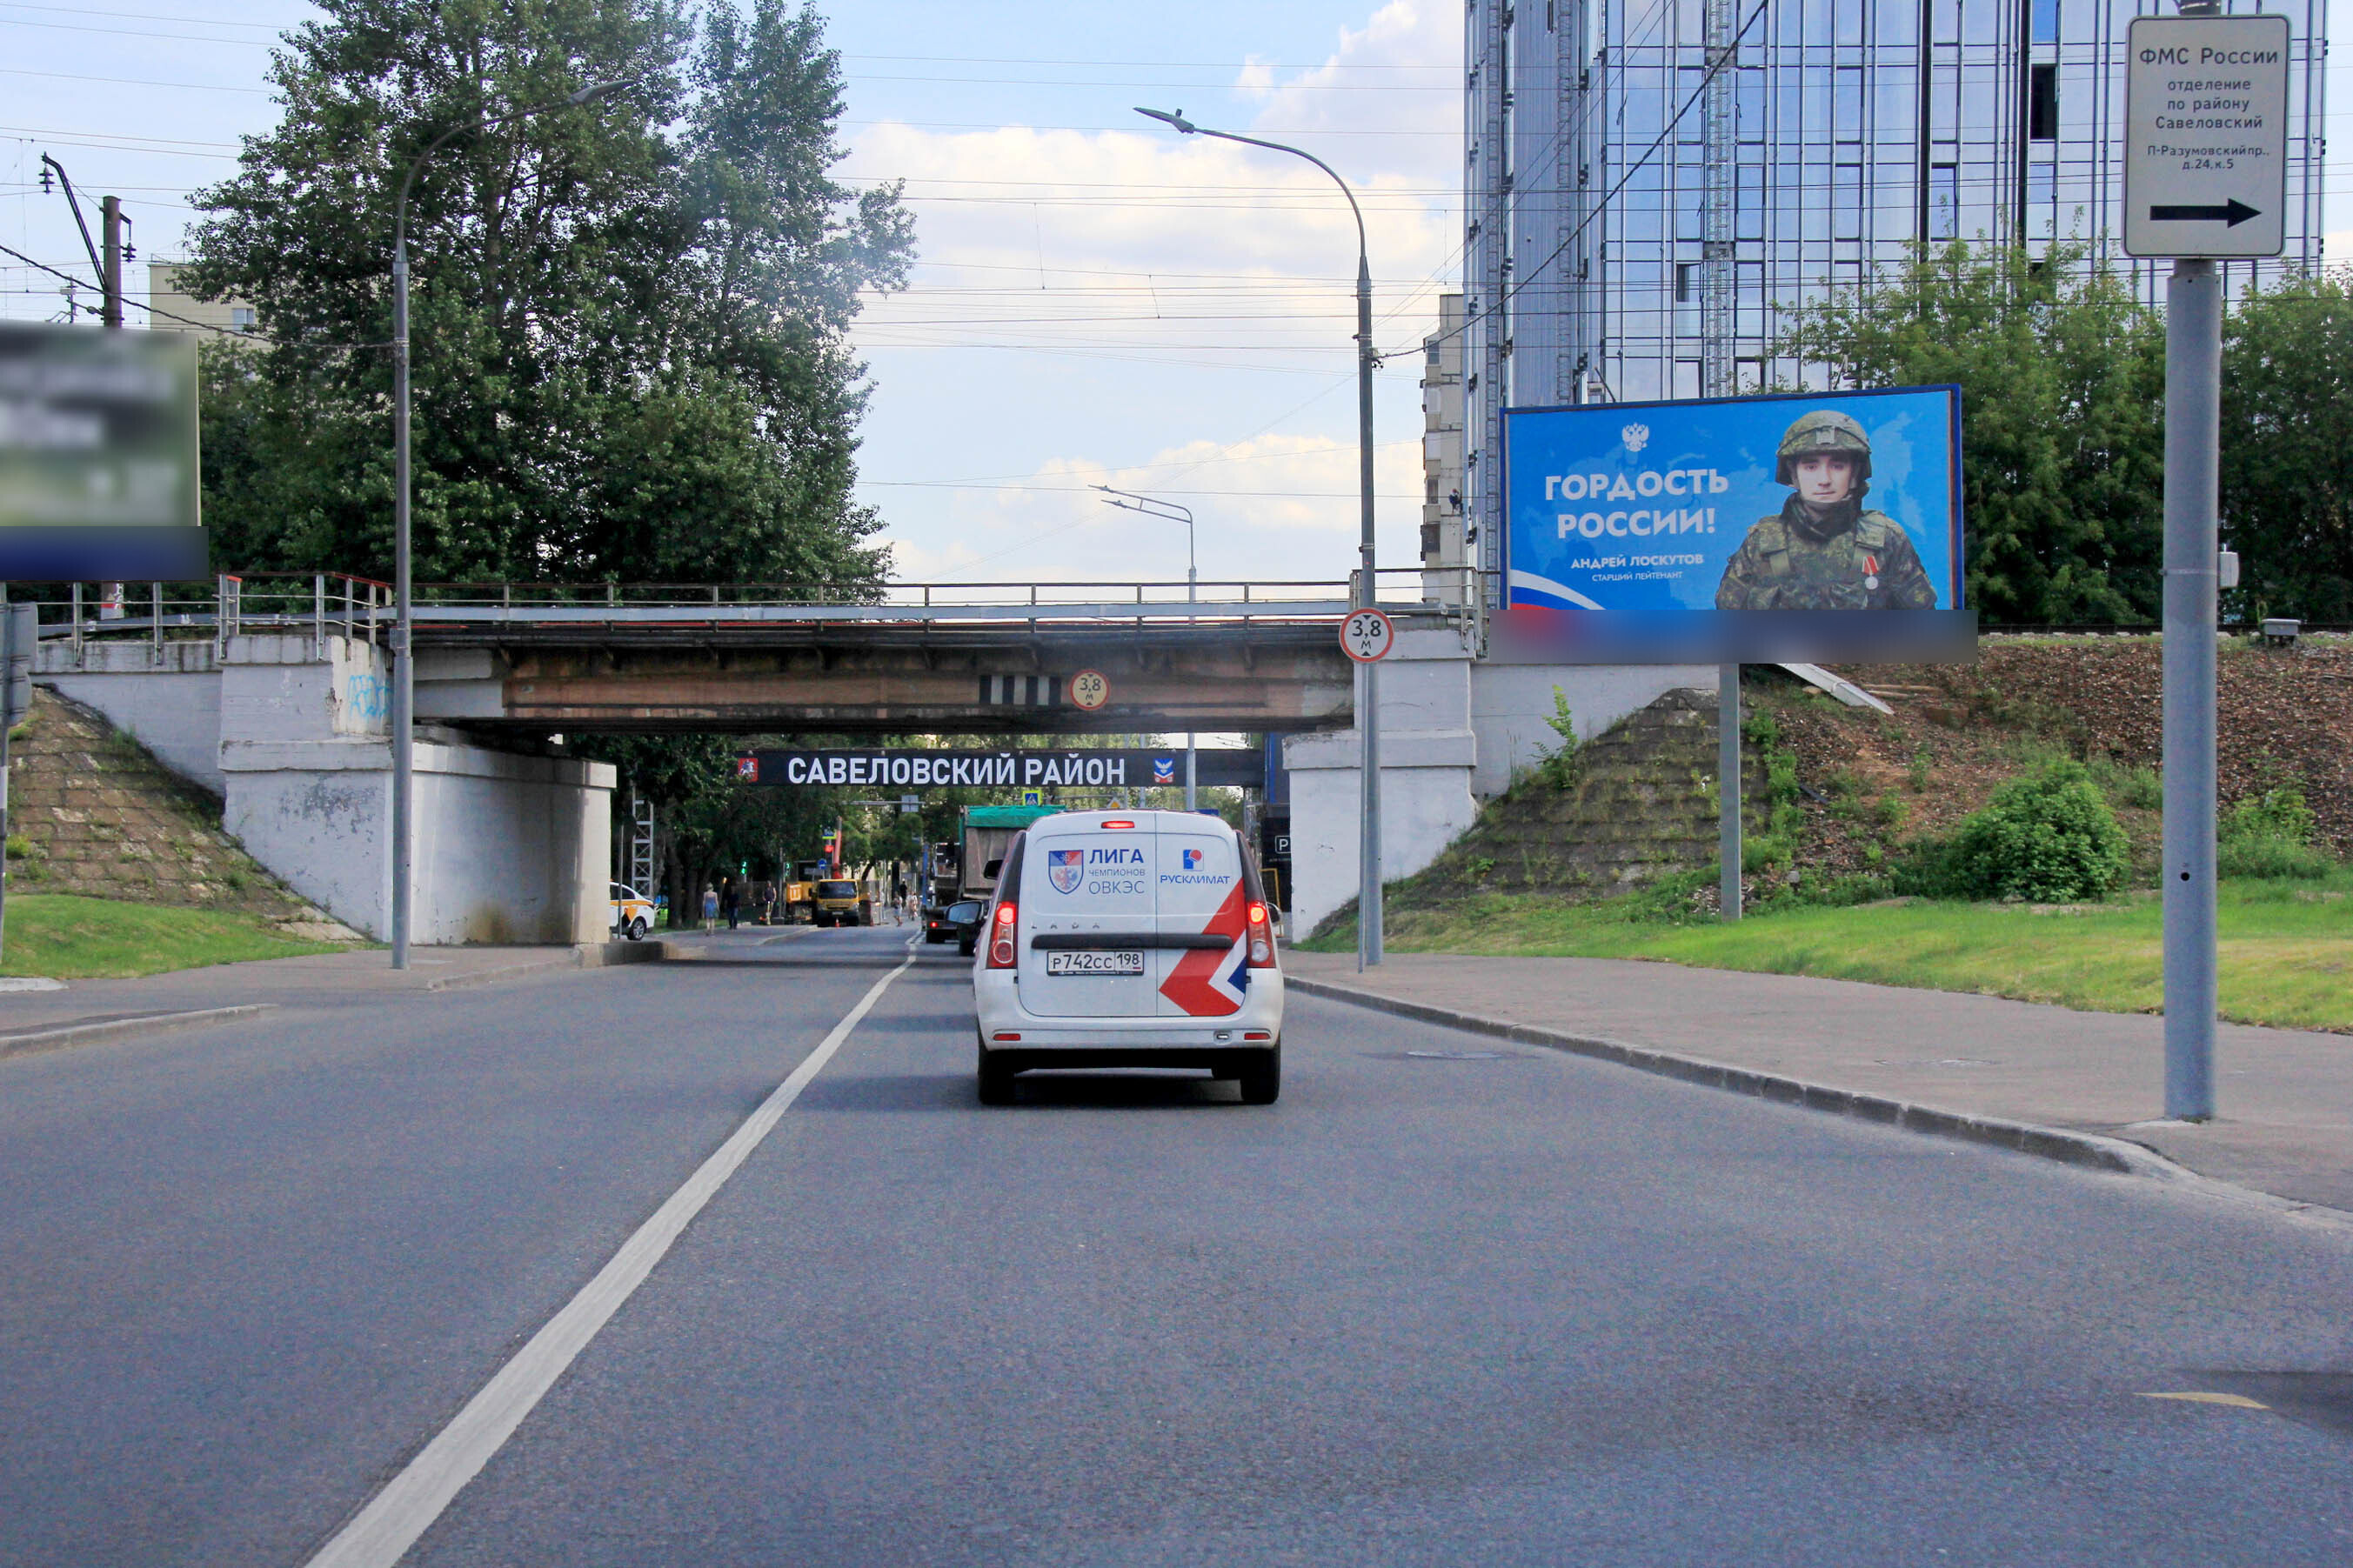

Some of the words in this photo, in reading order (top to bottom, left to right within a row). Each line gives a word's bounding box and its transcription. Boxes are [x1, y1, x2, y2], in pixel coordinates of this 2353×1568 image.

[2139, 48, 2189, 64] ФМС
[2201, 47, 2278, 64] России
[2168, 79, 2251, 92] отделение
[2168, 99, 2185, 110] по
[2193, 97, 2249, 112] району
[2156, 116, 2263, 130] Савеловский
[1545, 469, 1729, 502] ГОРДОСТЬ
[1558, 508, 1715, 539] РОССИИ!
[1571, 554, 1626, 570] АНДРЕЙ
[1629, 553, 1704, 567] ЛОСКУТОВ
[1592, 571, 1633, 582] СТАРШИЙ
[1634, 570, 1683, 581] ЛЕЙТЕНАНТ
[1352, 619, 1381, 638] 3,8
[1079, 678, 1101, 693] 3,8
[788, 752, 1015, 784] САВЕЛОВСКИЙ
[1025, 752, 1126, 784] РАЙОН
[1089, 849, 1144, 864] ЛИГА
[1088, 868, 1146, 877] ЧЕМПИОНОВ
[1160, 874, 1231, 884] РУСКЛИМАТ
[1088, 881, 1145, 895] ОВКЭС
[1117, 953, 1140, 965] 198
